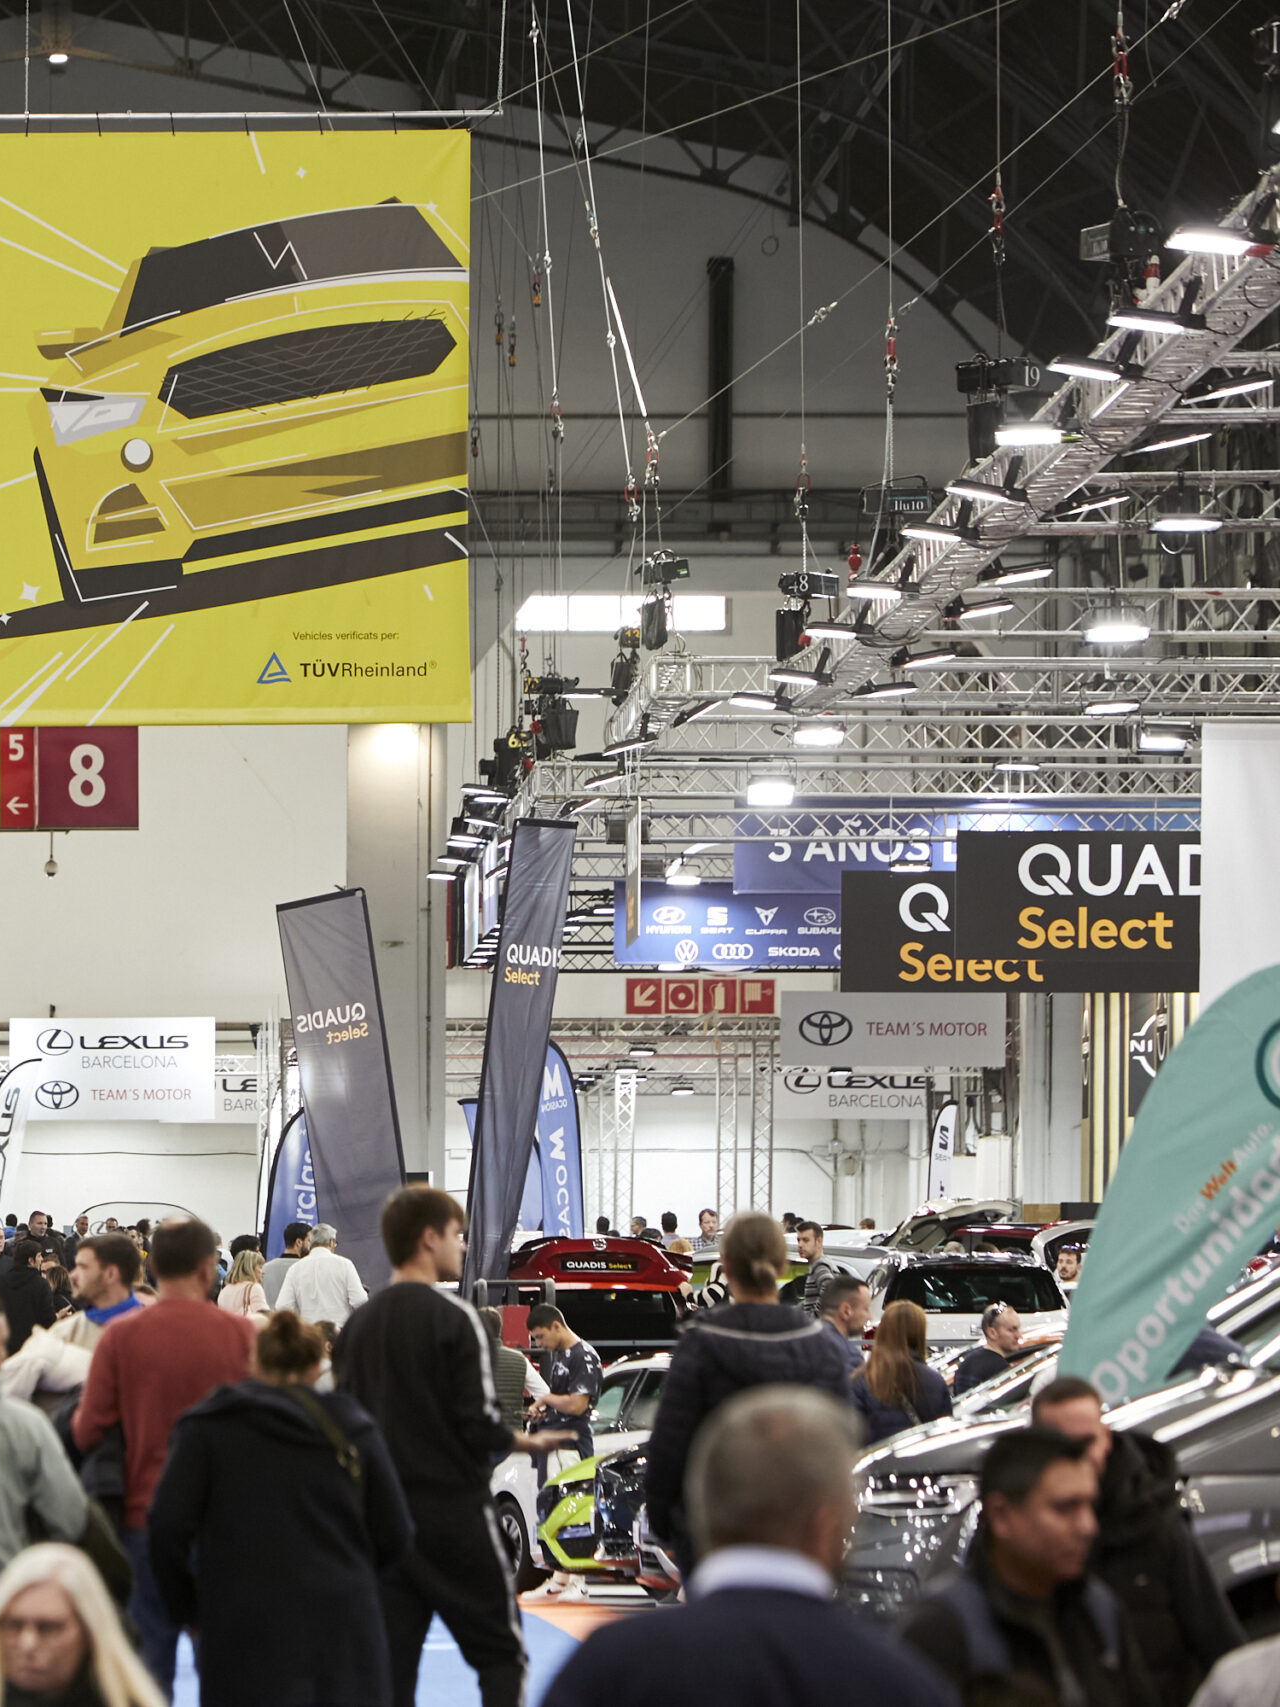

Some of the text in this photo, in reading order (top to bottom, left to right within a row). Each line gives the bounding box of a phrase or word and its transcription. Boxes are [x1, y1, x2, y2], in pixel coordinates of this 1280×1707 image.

[292, 631, 400, 642] Vehicles verificats per:
[8, 734, 25, 761] 5
[68, 744, 106, 807] 8
[802, 818, 931, 862] AÑOS
[646, 925, 692, 935] HYUNDAI
[1016, 906, 1174, 949] Select
[506, 943, 561, 968] QUADI
[768, 947, 821, 957] SKODA
[504, 966, 540, 986] Select
[929, 1022, 988, 1037] MOTOR
[80, 1035, 189, 1049] LEXUS
[81, 1056, 178, 1069] BARCELONA
[827, 1075, 926, 1089] LEXUS
[143, 1088, 191, 1101] MOTOR
[828, 1094, 925, 1108] BARCELONA
[566, 1261, 632, 1270] QUADIS Select
